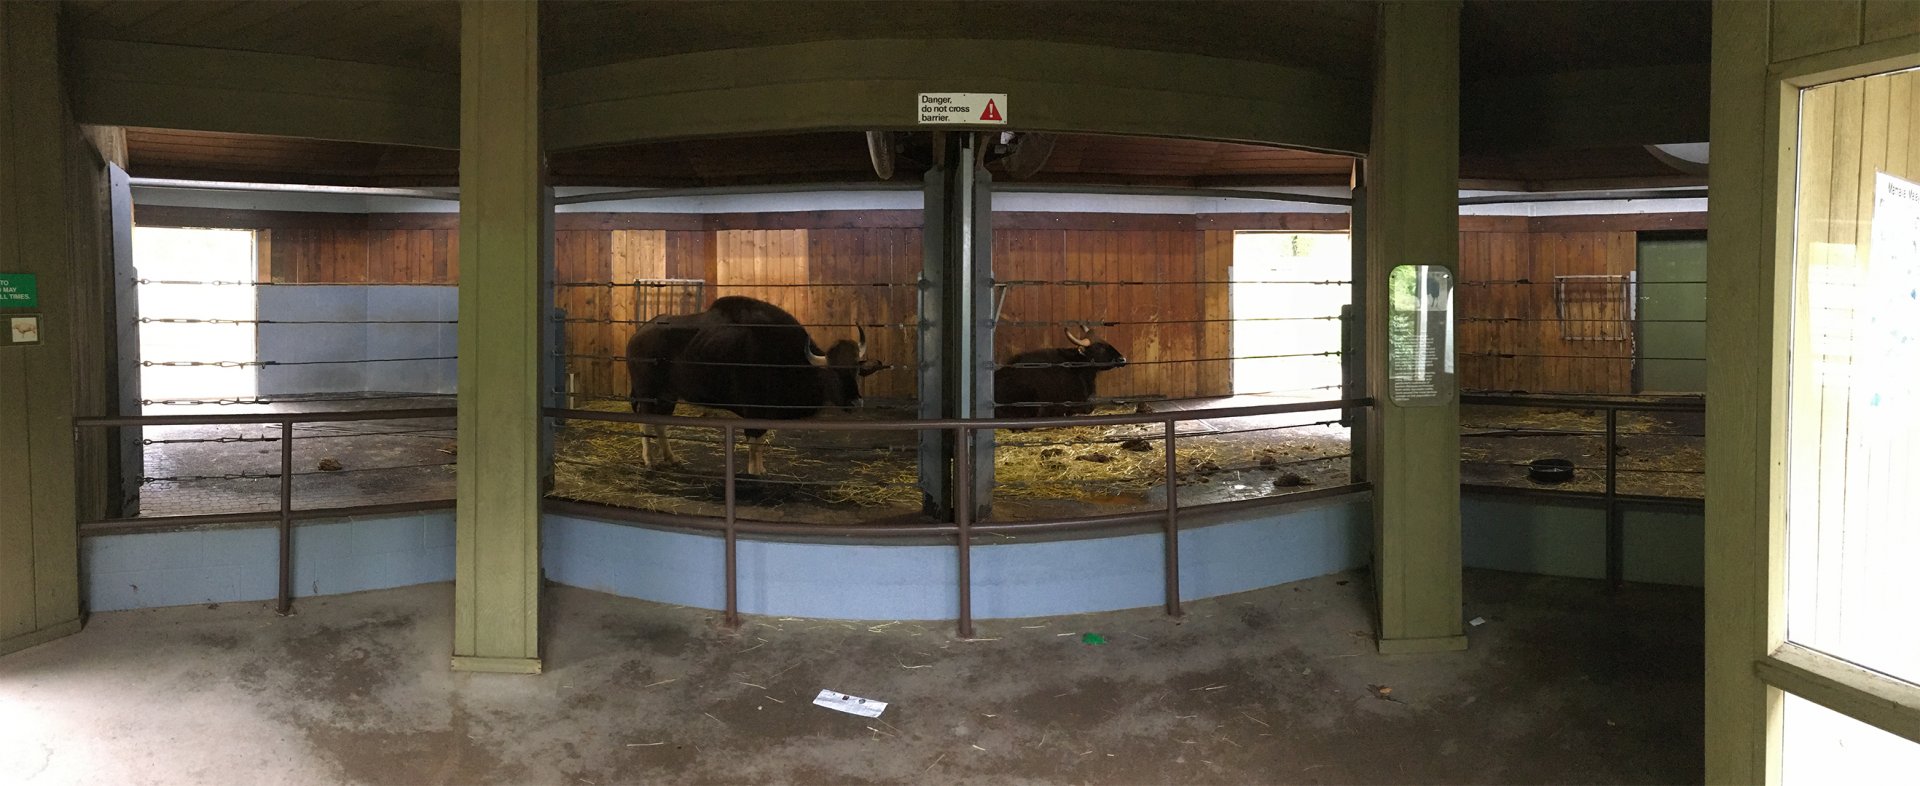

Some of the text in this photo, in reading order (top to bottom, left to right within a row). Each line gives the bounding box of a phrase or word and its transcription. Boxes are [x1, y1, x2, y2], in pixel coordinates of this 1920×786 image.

[921, 95, 953, 105] Danger,
[921, 105, 932, 113] do
[933, 105, 947, 113] not
[921, 113, 950, 122] barrier.
